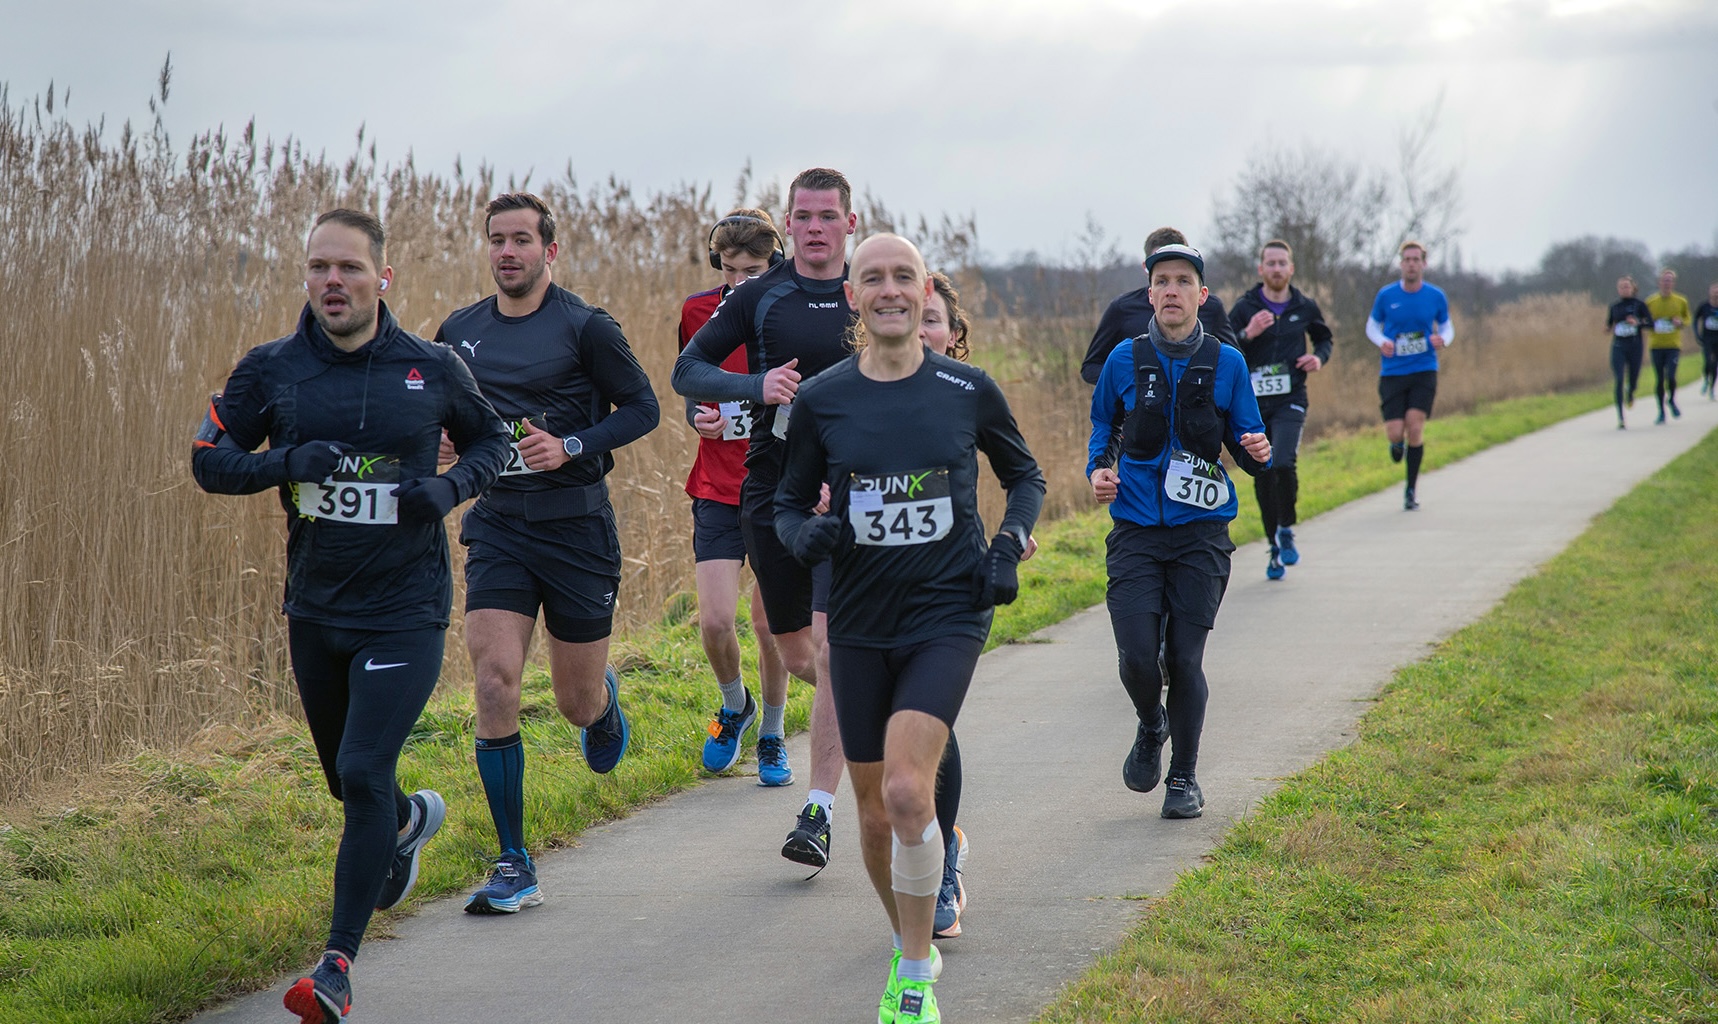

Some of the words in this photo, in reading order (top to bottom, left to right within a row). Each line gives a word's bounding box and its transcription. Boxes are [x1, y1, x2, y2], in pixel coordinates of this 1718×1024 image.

[935, 370, 967, 387] CRAFT
[1257, 378, 1283, 394] 353
[860, 469, 934, 499] RUNX
[1176, 476, 1219, 507] 310
[317, 484, 378, 520] 391
[865, 504, 937, 542] 343
